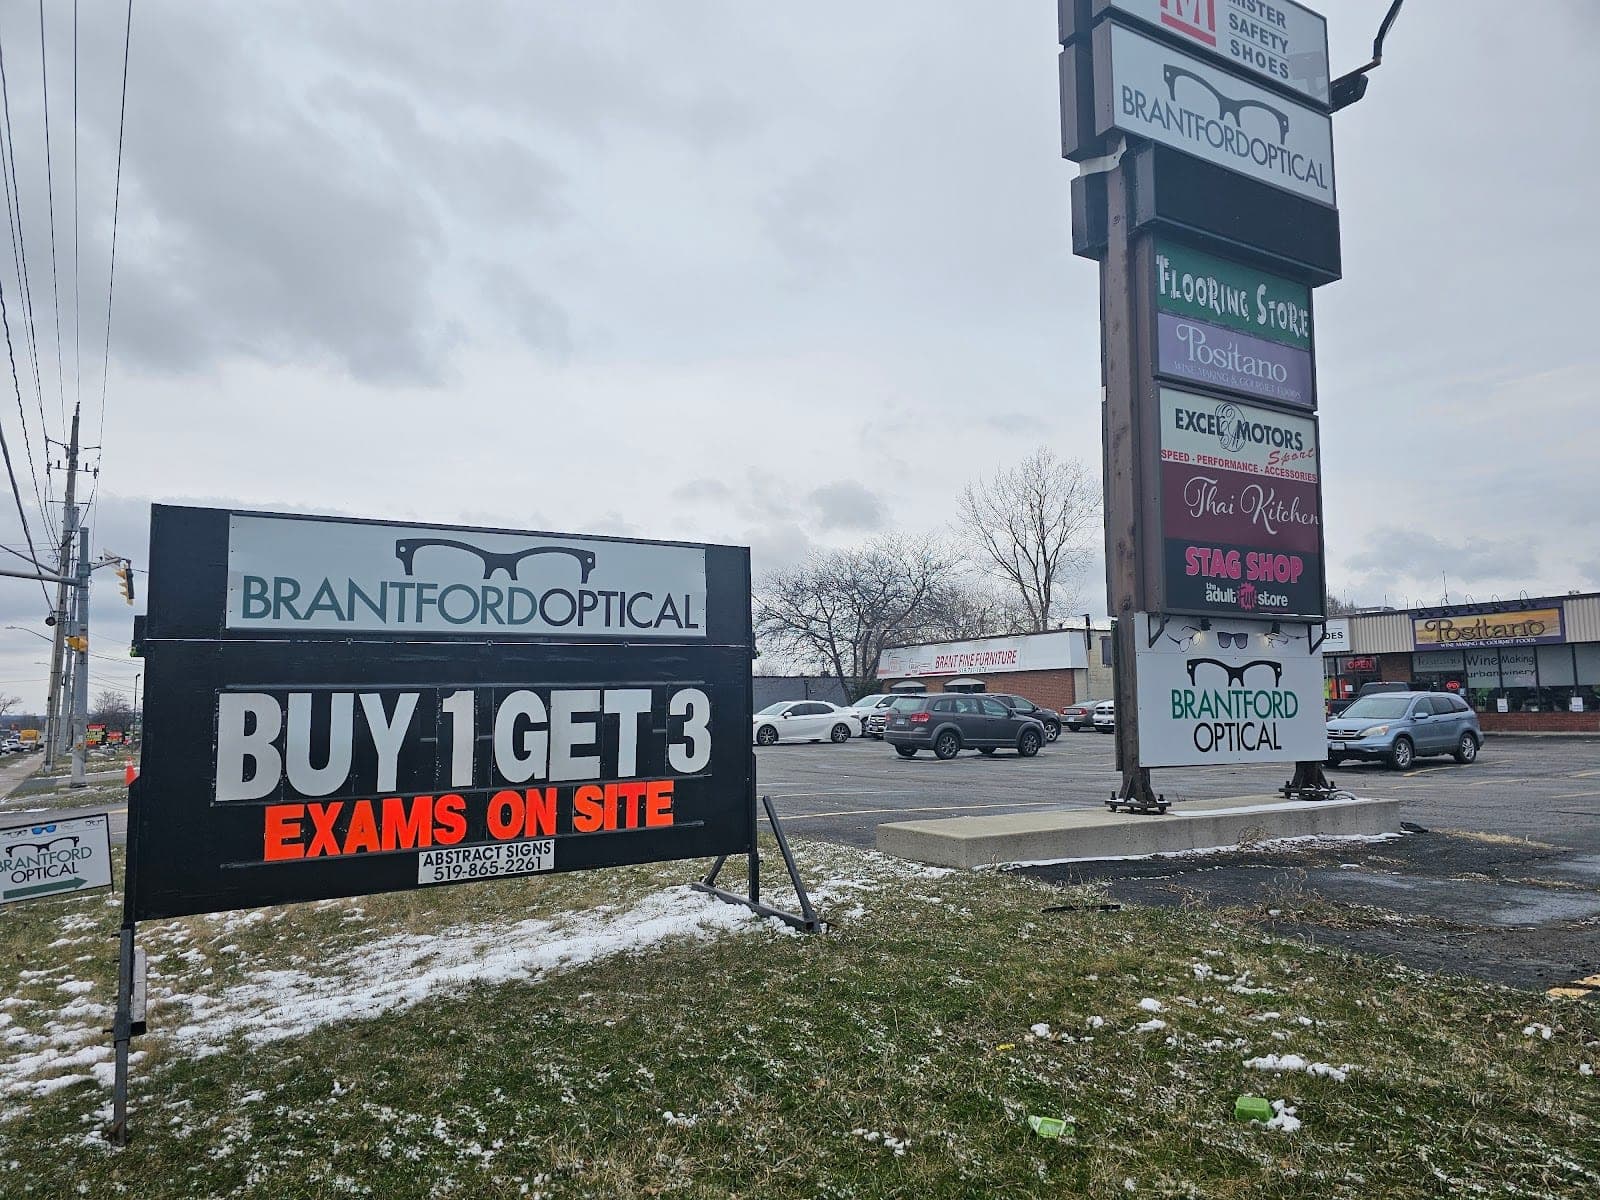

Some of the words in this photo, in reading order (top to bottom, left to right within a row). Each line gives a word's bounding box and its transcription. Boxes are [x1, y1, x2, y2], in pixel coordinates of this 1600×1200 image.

[1229, 12, 1288, 54] SAFETY
[1231, 39, 1289, 79] SHOES
[1156, 254, 1249, 322] FLOORING
[1256, 284, 1308, 338] STORE
[1176, 324, 1287, 382] Positano
[1175, 408, 1226, 437] EXCEL
[1237, 420, 1303, 451] MOTORS
[1161, 449, 1190, 462] SPEED
[1197, 454, 1258, 473] PERFORMANCE
[1264, 466, 1317, 482] ACCESSORIES
[1184, 476, 1235, 518] Thai
[1240, 484, 1319, 535] Kitchen
[1185, 546, 1241, 580] STAG
[1246, 551, 1303, 584] SHOP
[1206, 588, 1236, 603] adult
[1258, 591, 1288, 606] store
[1425, 618, 1545, 642] Positano
[935, 655, 958, 669] BRANT
[958, 653, 975, 668] FINE
[975, 650, 1017, 667] FURNITURE
[1347, 659, 1372, 669] OPEN
[1467, 655, 1498, 666] Wine
[1502, 654, 1535, 666] Making
[1171, 689, 1298, 719] BRANTFORD
[215, 691, 420, 802] BUY
[442, 689, 475, 787] 1
[494, 689, 652, 783] GET
[668, 688, 712, 774] 3
[1194, 722, 1282, 753] OPTICAL
[264, 793, 467, 862] EXAMS
[486, 788, 558, 840] ON
[573, 781, 674, 833] SITE
[423, 846, 503, 867] ABSTRACT
[506, 841, 550, 858] SIGNS
[433, 856, 541, 881] 519-865-2261
[11, 862, 79, 883] OPTICAL
